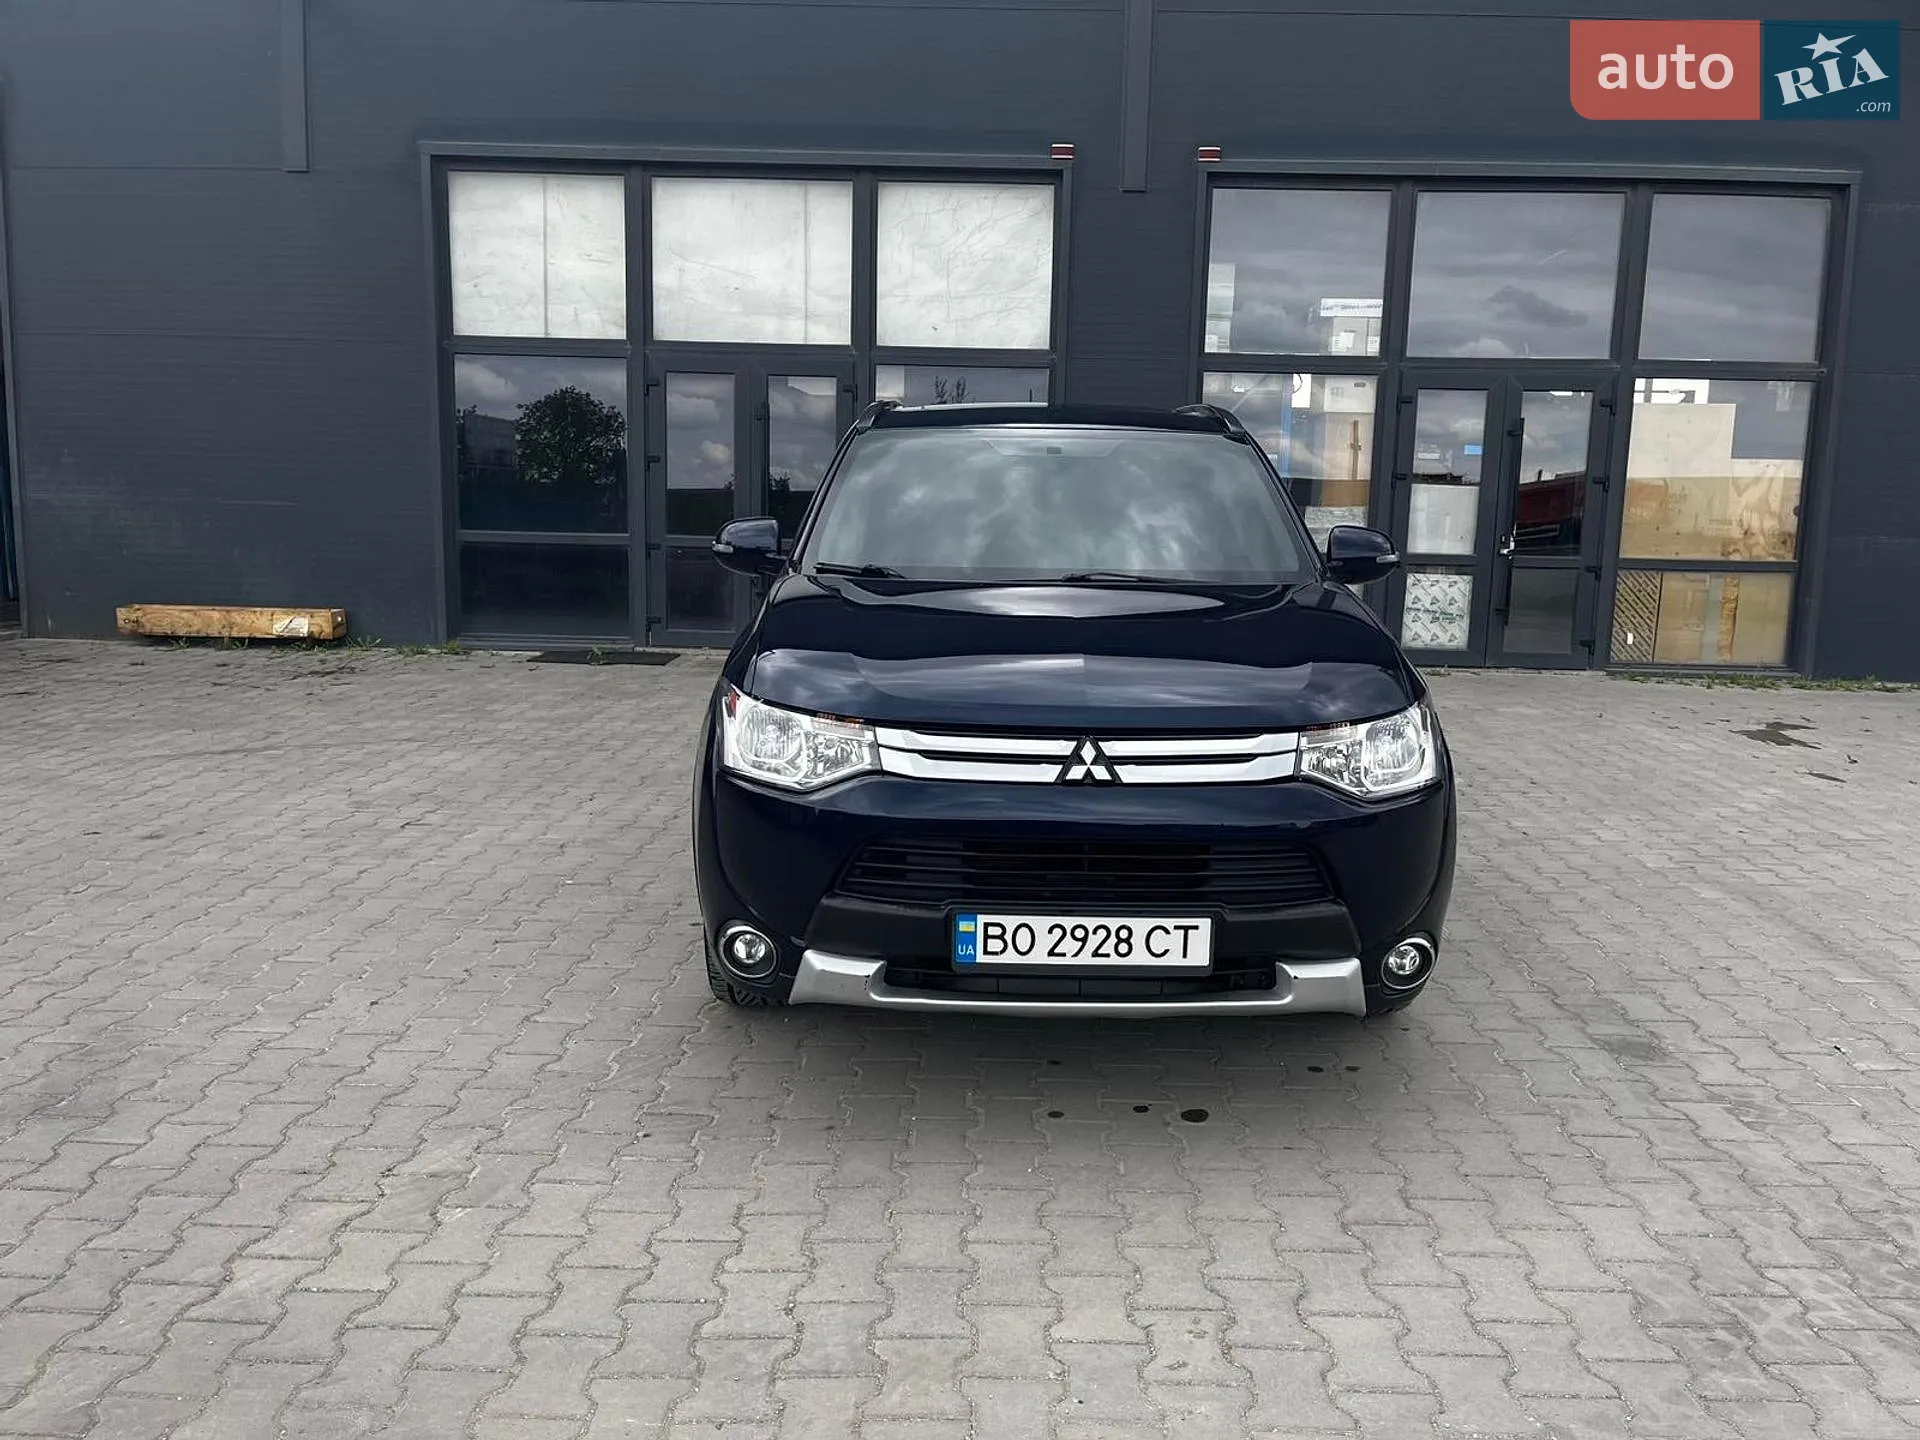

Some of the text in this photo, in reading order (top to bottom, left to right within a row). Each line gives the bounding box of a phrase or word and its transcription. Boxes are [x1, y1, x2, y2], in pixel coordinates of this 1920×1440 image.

[958, 944, 975, 955] UA
[982, 922, 1200, 959] BO 2928 CT
